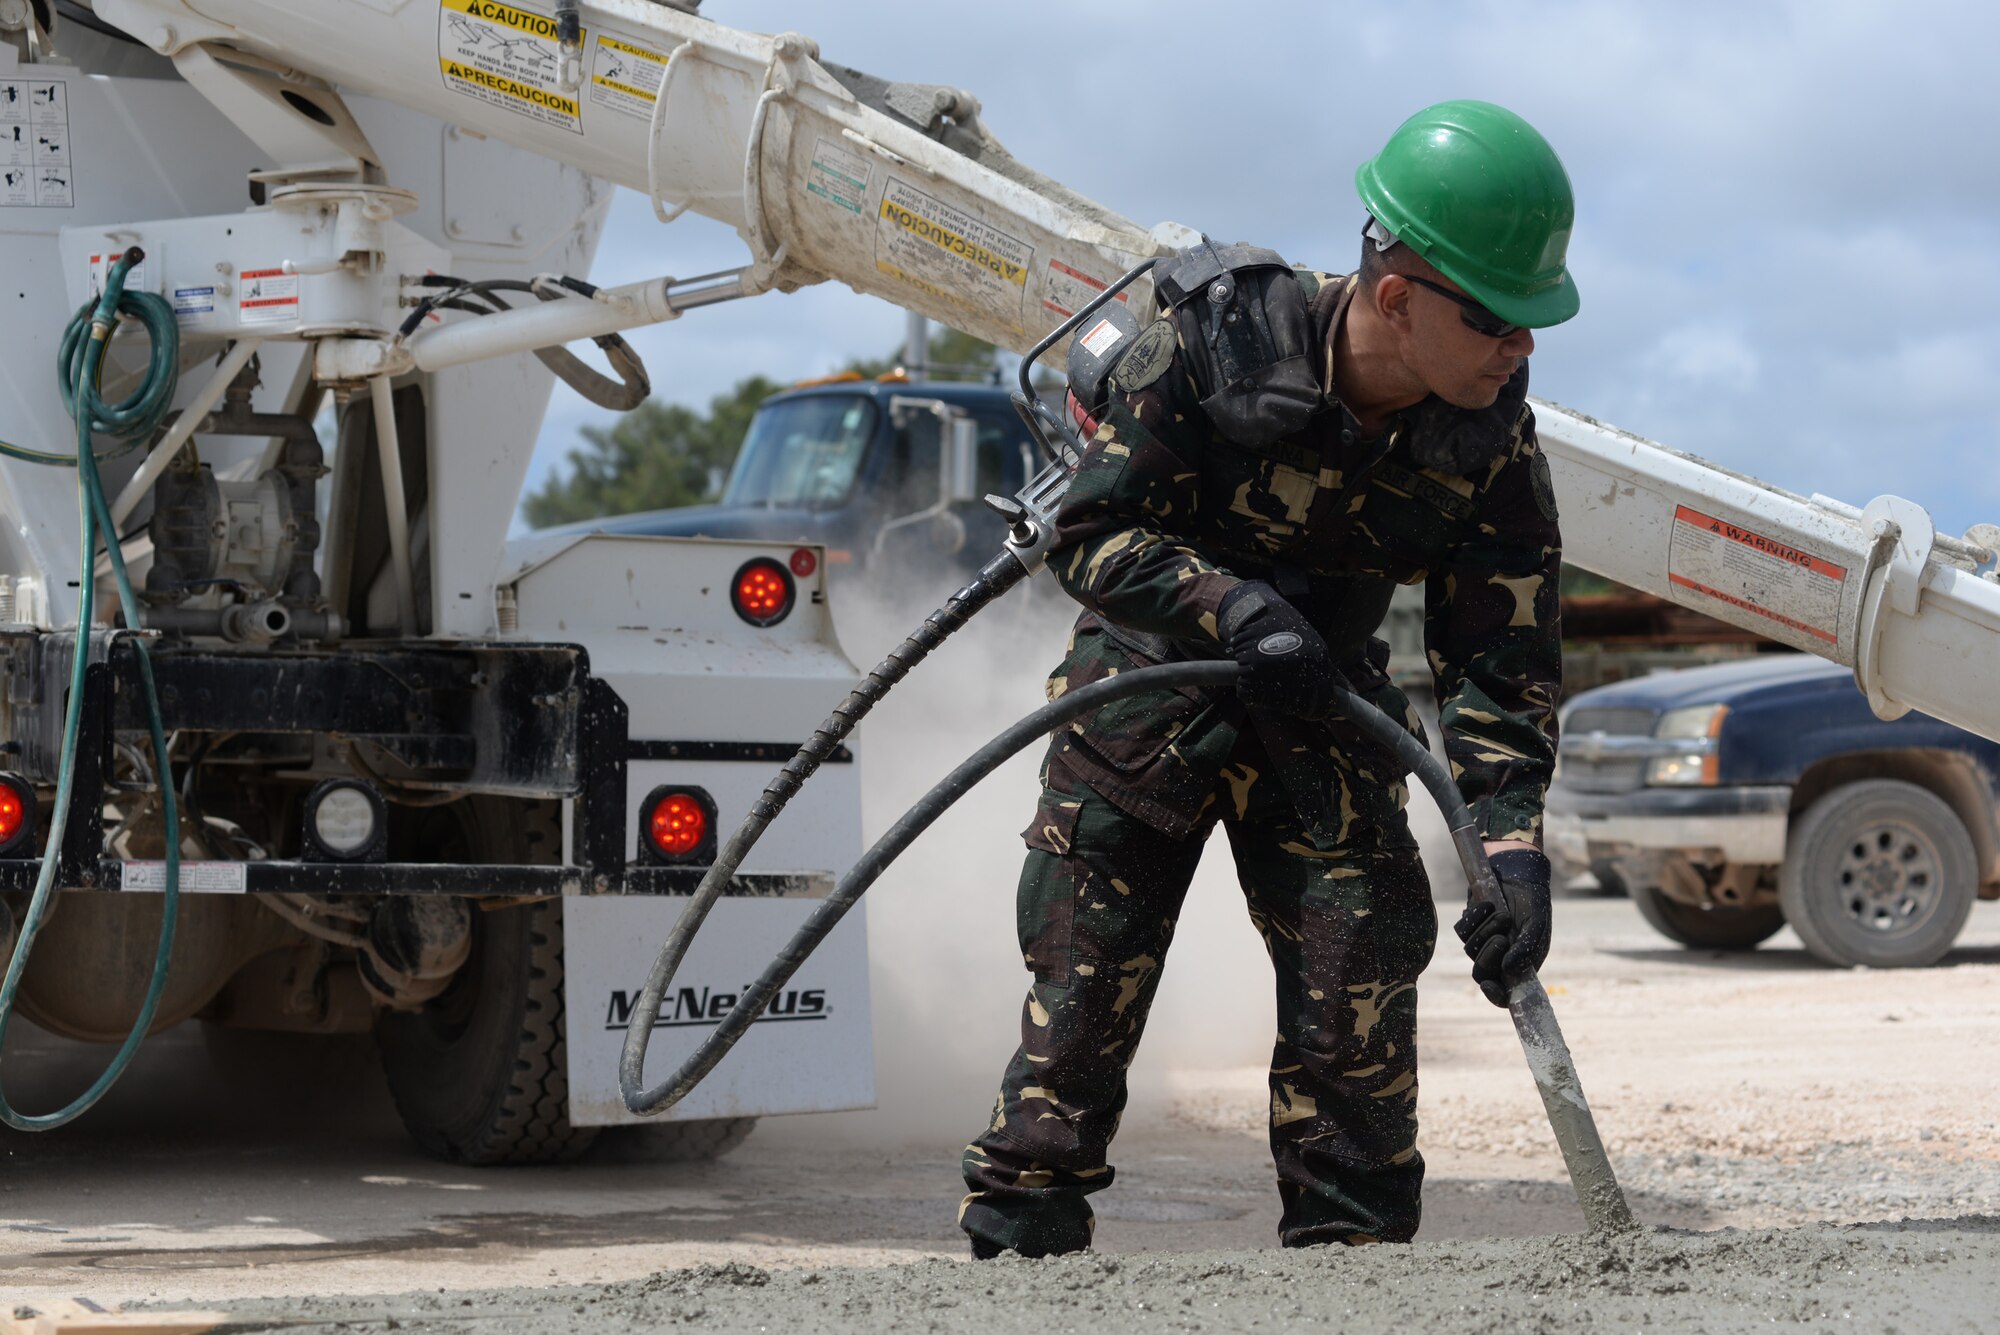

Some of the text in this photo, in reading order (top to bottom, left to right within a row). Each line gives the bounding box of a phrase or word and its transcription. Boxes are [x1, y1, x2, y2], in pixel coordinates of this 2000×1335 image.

[457, 47, 558, 84] KEEP HANDS AND BODY AWA
[623, 45, 661, 62] CAUTION
[463, 67, 574, 114] PRECAUCION
[474, 61, 543, 88] FROM PIVOT POINTS
[449, 77, 486, 93] MANTENGA
[488, 88, 502, 97] LAS
[503, 93, 528, 107] MANOS
[536, 105, 545, 113] EL
[546, 108, 575, 123] CUERPO
[455, 85, 573, 128] FUERA DE LAS PUNTAS DEL PIVOTE
[890, 194, 919, 214] CUERPO
[897, 187, 1020, 252] FUERA DE LAS PUNTAS DEL PIVOTE
[922, 210, 930, 219] EL
[886, 205, 1002, 274] PRECAUCION
[938, 218, 964, 236] MANOS
[967, 232, 980, 244] LAS
[982, 240, 1022, 265] MANTENGA
[1379, 464, 1470, 517] AIR FORCE
[1726, 525, 1813, 568] WARNING
[1708, 589, 1811, 634] ADVERTENCIA
